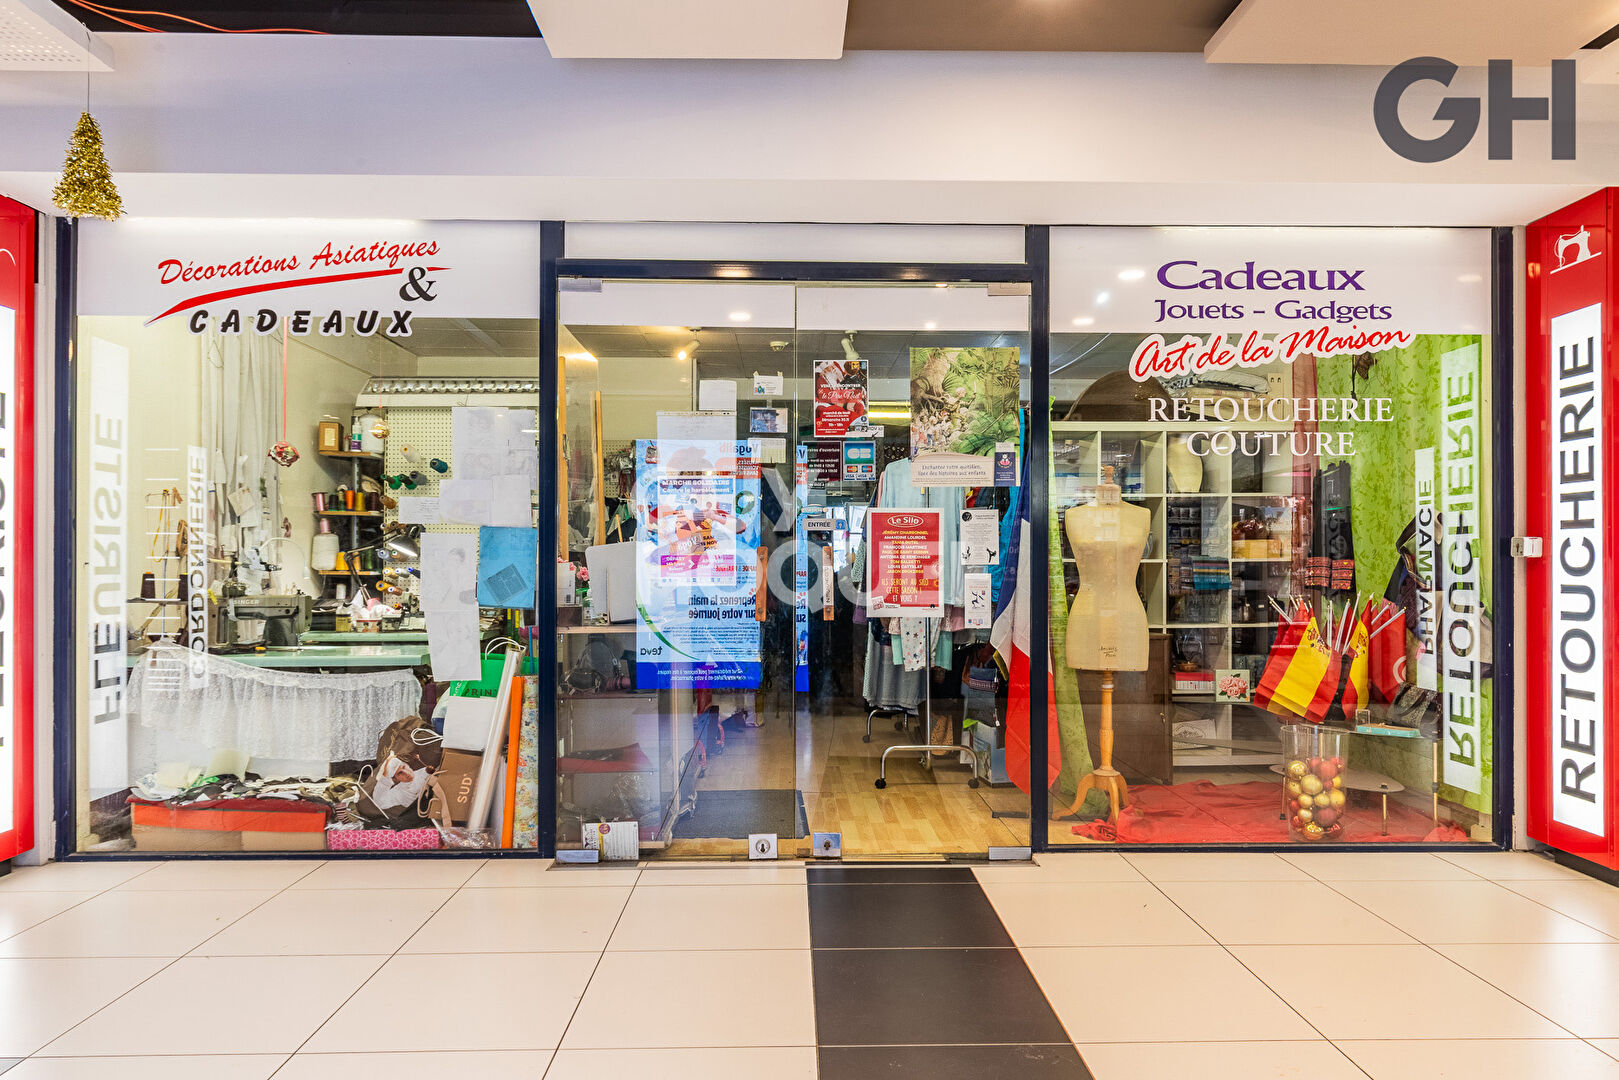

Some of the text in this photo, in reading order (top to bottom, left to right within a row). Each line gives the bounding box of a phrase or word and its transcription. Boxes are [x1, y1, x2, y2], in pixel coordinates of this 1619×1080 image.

[158, 240, 440, 285] Décorations Asiatiques
[399, 266, 437, 301] &
[1157, 261, 1366, 291] Cadeaux
[190, 309, 413, 333] CADEAUX
[1155, 300, 1244, 323] Jouets
[1274, 300, 1392, 324] Gadgets
[1135, 325, 1410, 377] Art de la Maison
[1148, 398, 1394, 422] RETOUCHERIE
[847, 448, 871, 459] CB
[1187, 432, 1356, 456] COUTURE
[807, 520, 831, 528] ENTRÉE
[903, 516, 919, 524] Silo
[1559, 336, 1598, 804] RETOUCHERIE
